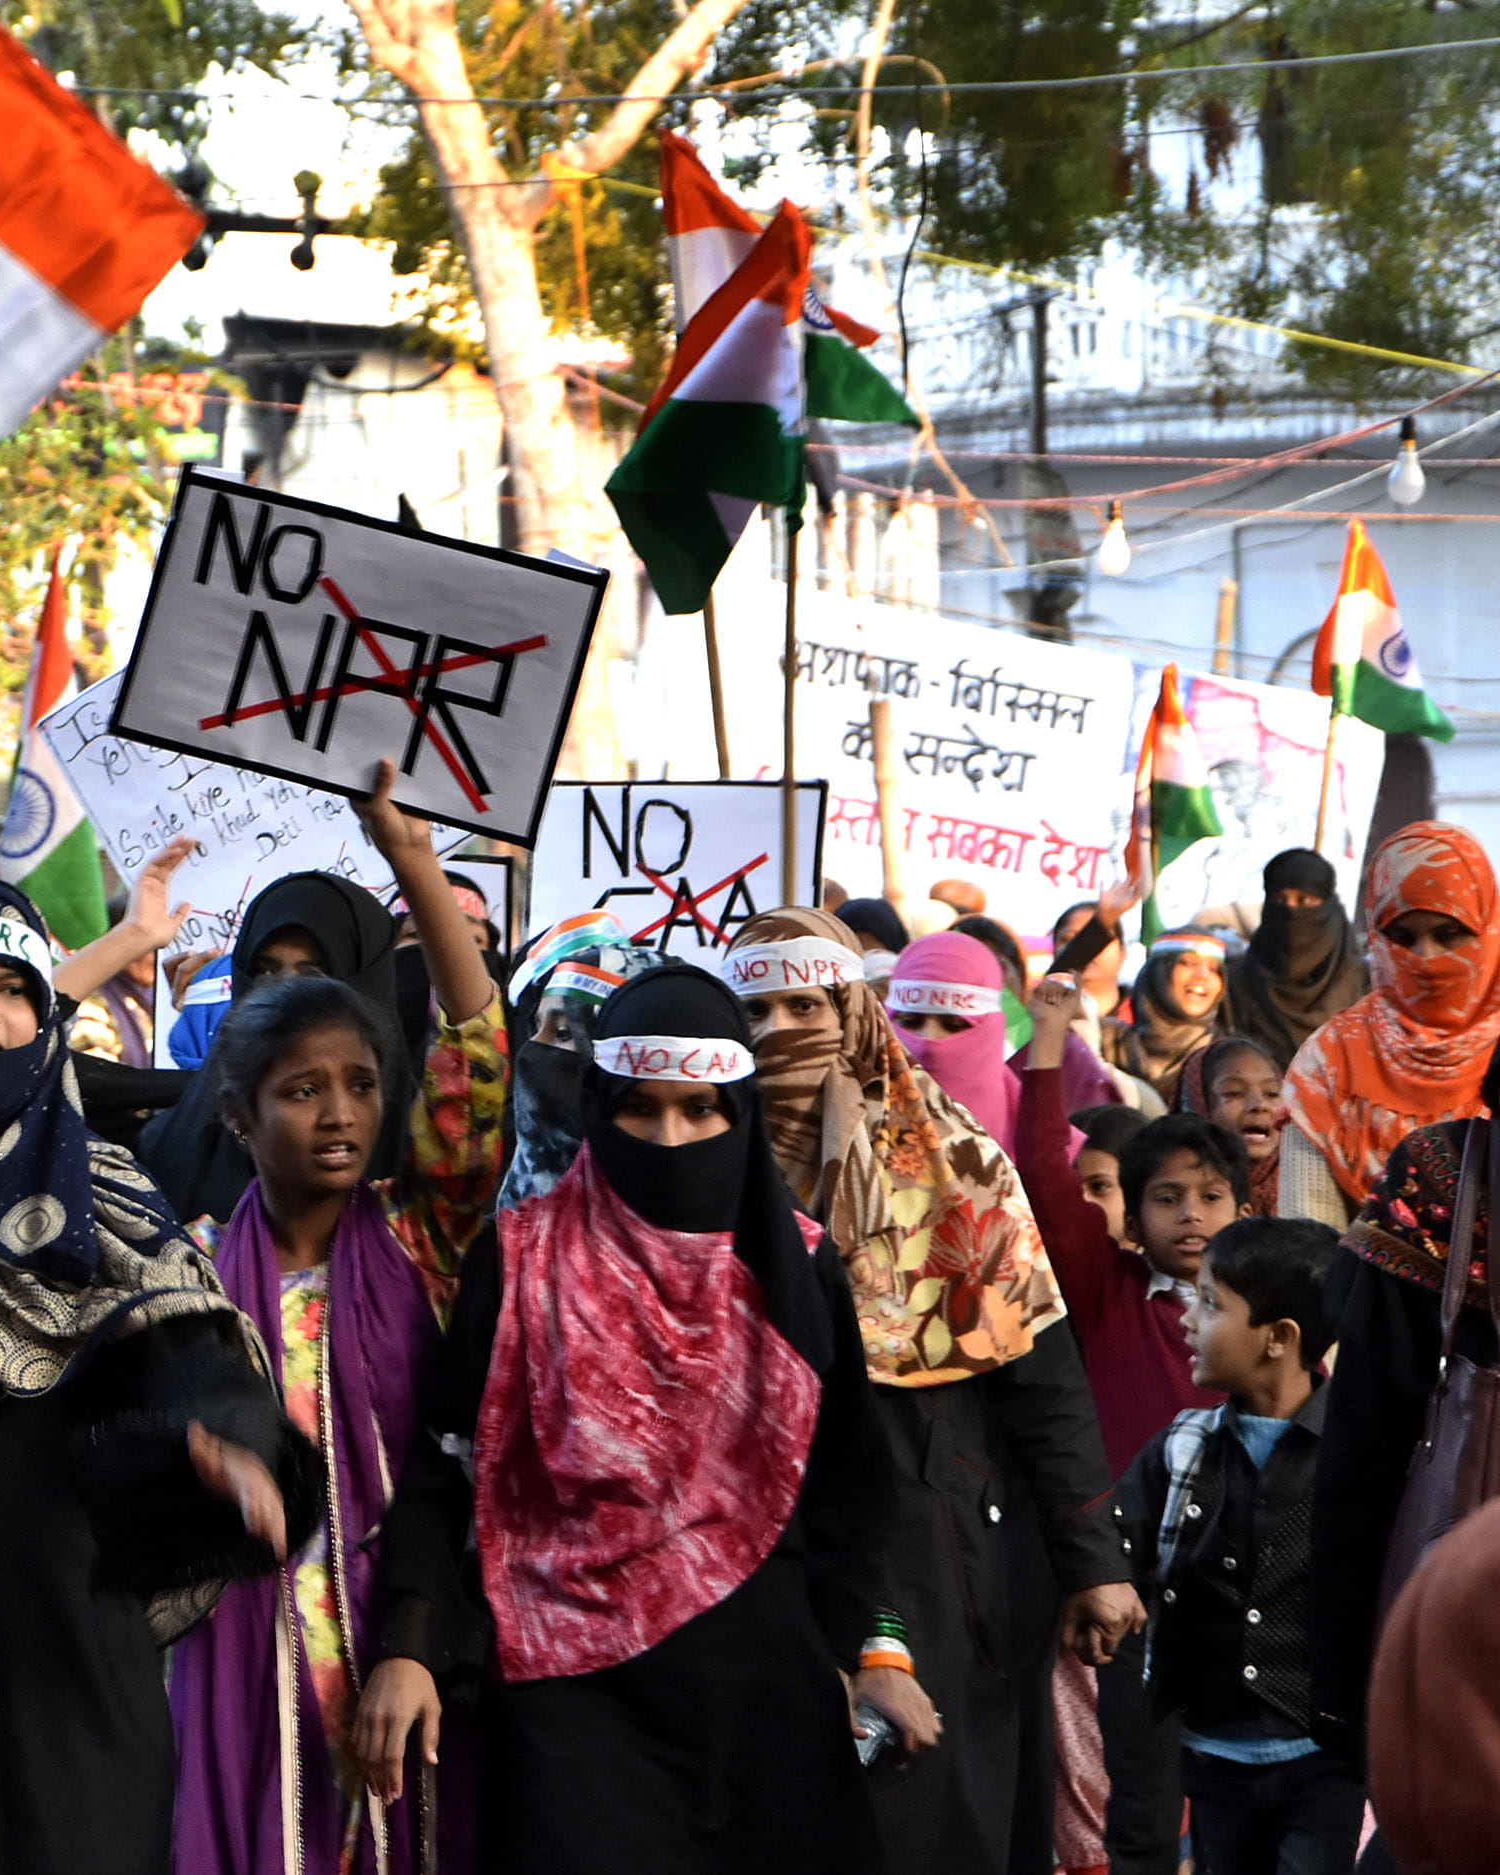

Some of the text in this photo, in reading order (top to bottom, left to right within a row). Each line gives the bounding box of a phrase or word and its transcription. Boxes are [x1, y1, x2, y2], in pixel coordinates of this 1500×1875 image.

[193, 491, 324, 604] NO
[222, 609, 517, 796] NPR
[582, 785, 693, 878] NO
[926, 813, 1037, 873] सबका
[733, 958, 846, 986] NO NPR
[894, 986, 977, 1010] NO NRC
[613, 1041, 671, 1076] NO
